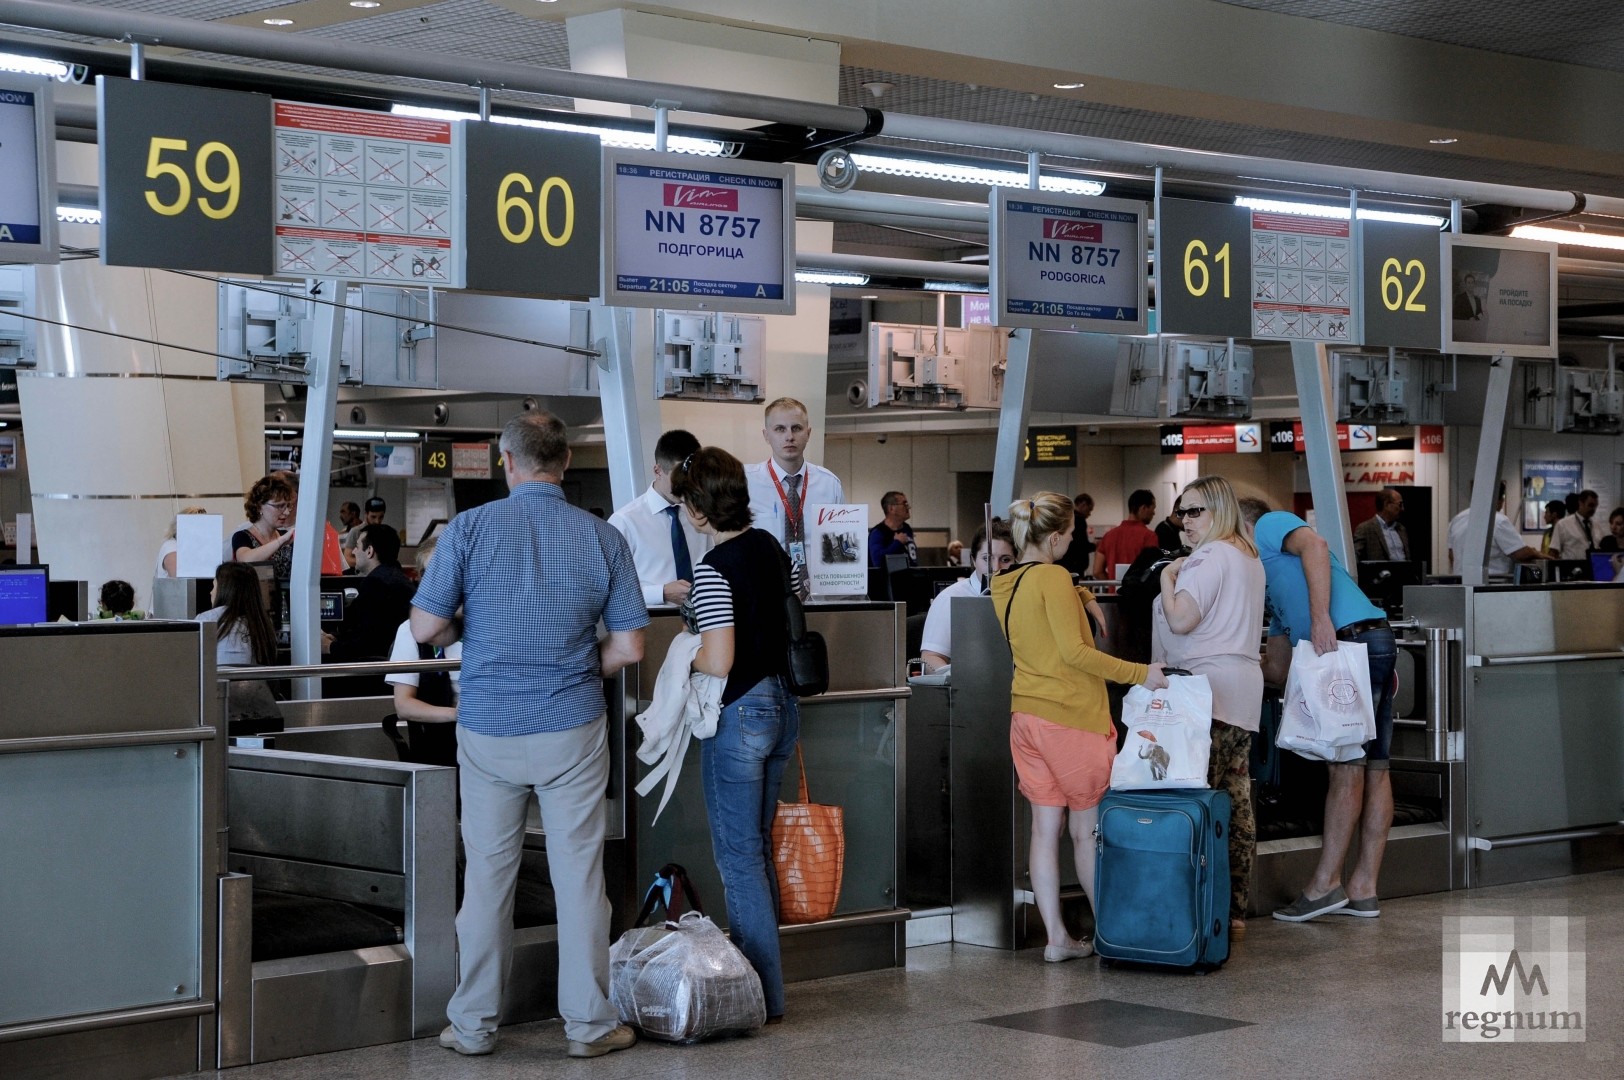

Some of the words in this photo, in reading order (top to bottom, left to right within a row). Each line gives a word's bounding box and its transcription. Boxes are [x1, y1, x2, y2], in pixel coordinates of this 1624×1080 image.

[618, 166, 638, 175] 18:36
[649, 169, 711, 182] РЕГИСТРАЦИЯ
[145, 137, 241, 220] 59
[718, 175, 747, 186] CHECK
[748, 178, 757, 186] IN
[758, 179, 778, 188] NOW
[496, 172, 575, 247] 60
[1032, 205, 1081, 217] РЕГИСТРАЦИЯ
[1087, 211, 1109, 220] CHECK
[1110, 213, 1117, 221] IN
[1118, 214, 1135, 222] NOW
[645, 209, 685, 234] NN
[699, 214, 761, 239] 8757
[0, 224, 15, 241] A
[658, 242, 744, 260] ПОДГОРИЦА
[1029, 241, 1060, 263] NN
[1071, 245, 1121, 268] 8757
[1183, 239, 1230, 297] 61
[1040, 270, 1106, 285] PODGORICA
[618, 283, 647, 291] Departure
[650, 278, 690, 293] 21:05
[755, 284, 767, 297] A
[1381, 258, 1426, 312] 62
[1500, 288, 1528, 297] ПРОЙДИТЕ
[1032, 302, 1064, 315] 21:05
[1508, 299, 1532, 308] ПОСАДКУ
[1115, 307, 1125, 320] A
[428, 452, 446, 468] 43
[1344, 472, 1356, 483] L
[1358, 471, 1414, 484] AIRLIN
